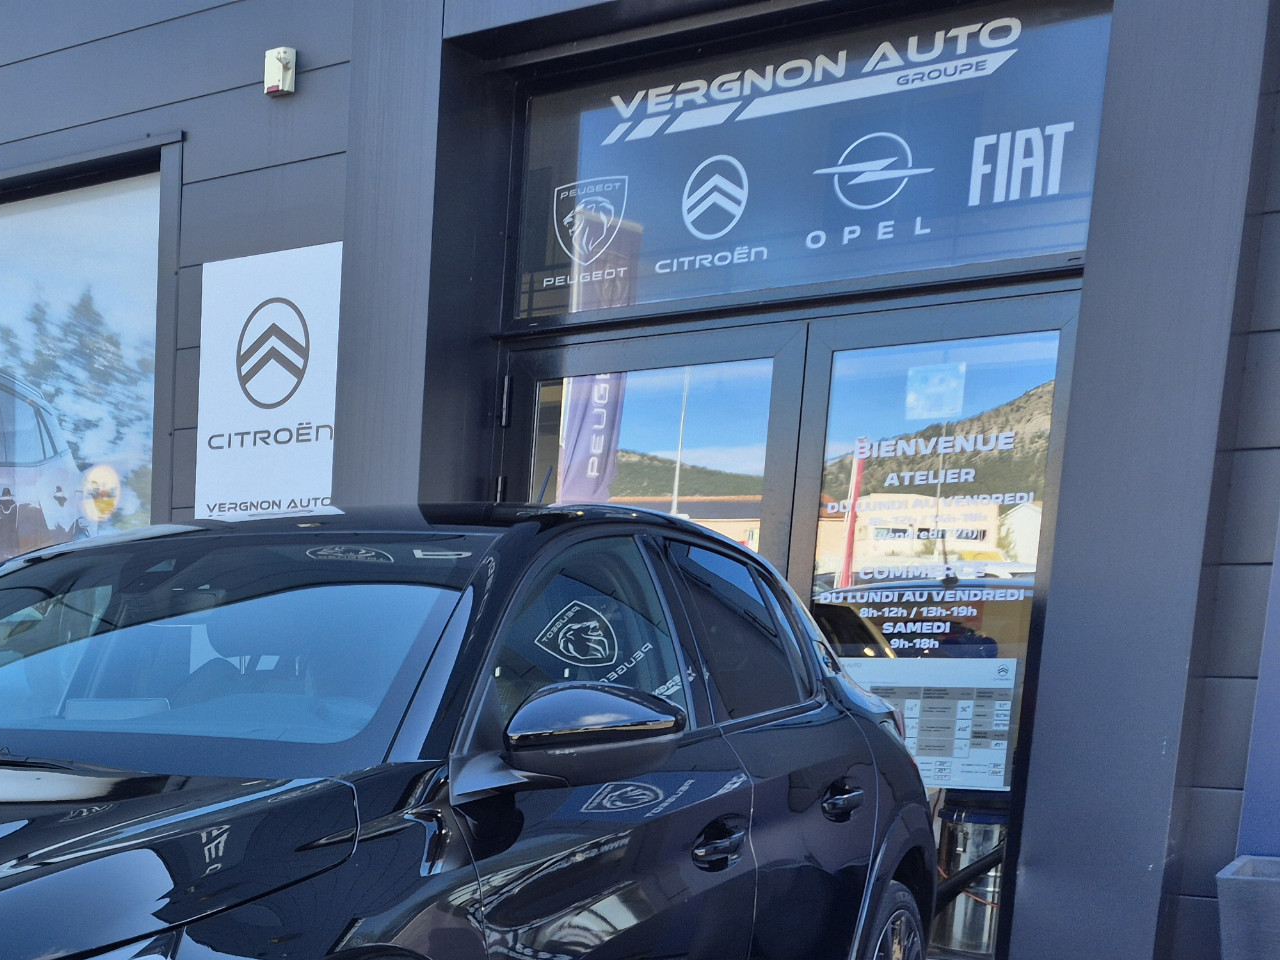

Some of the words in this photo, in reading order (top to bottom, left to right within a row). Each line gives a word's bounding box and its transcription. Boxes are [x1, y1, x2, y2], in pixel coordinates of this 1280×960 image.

[610, 50, 847, 119] VERGNON
[861, 18, 1022, 71] AUTO
[895, 59, 988, 87] GROUPE
[967, 121, 1074, 207] FIAT
[559, 182, 622, 200] PEUGEOT
[804, 216, 931, 249] OPEL
[542, 266, 628, 288] PEUGEOT
[855, 432, 1015, 458] BIENVENUE
[884, 468, 976, 487] ATELIER
[206, 499, 283, 514] VERGNON
[286, 496, 332, 510] AUTO
[826, 501, 851, 514] DU
[940, 491, 1035, 508] VENDREDI
[858, 563, 986, 580] COMMERCE
[820, 591, 849, 604] DU
[850, 591, 899, 604] LUNDI
[900, 590, 929, 603] AU
[932, 588, 1025, 603] VENDREDI
[859, 606, 908, 618] 8h-12h
[920, 605, 978, 618] 13h-19h
[882, 622, 951, 635] SAMEDI
[890, 638, 939, 650] 9h-18h
